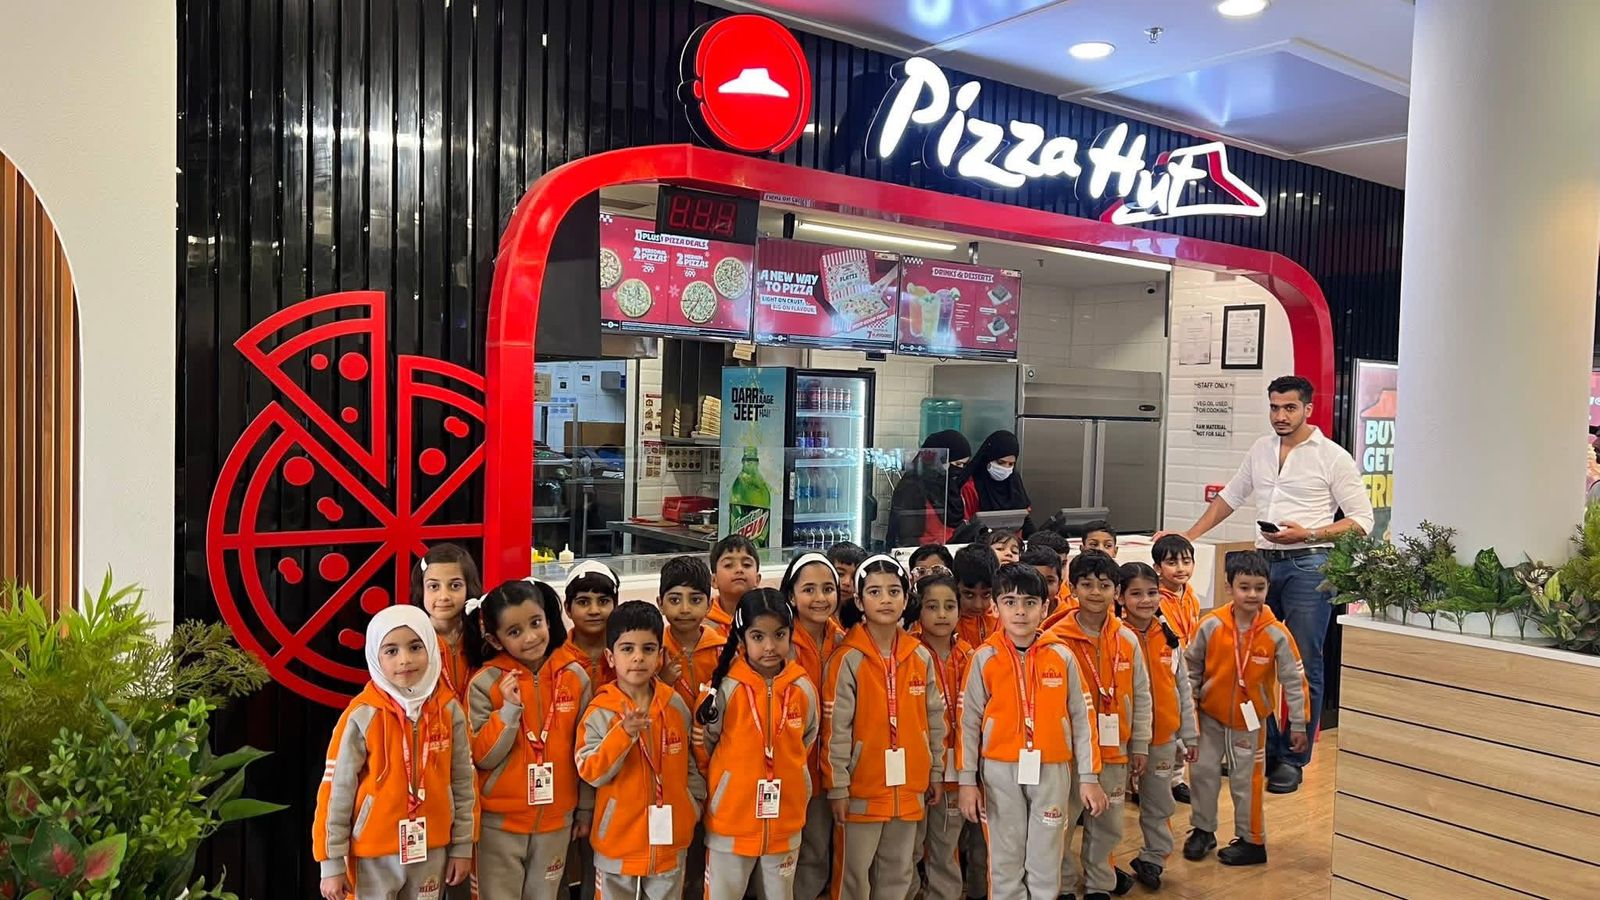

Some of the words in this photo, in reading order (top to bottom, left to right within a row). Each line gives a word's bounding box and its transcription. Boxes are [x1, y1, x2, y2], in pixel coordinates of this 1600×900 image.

[880, 56, 1082, 188] Pizza
[1088, 122, 1206, 216] Hut
[642, 232, 660, 241] PLUS
[664, 236, 684, 246] PIZZA
[686, 240, 706, 248] DEALS
[634, 247, 642, 260] 2
[642, 254, 668, 262] PIZZAS
[676, 253, 684, 265] 2
[684, 259, 709, 268] PIZZAS
[760, 270, 769, 280] A
[770, 270, 794, 282] NEW
[796, 272, 818, 285] WAY
[934, 268, 957, 276] DRINKS
[964, 272, 992, 282] DESSERTS
[765, 281, 781, 292] TO
[782, 283, 813, 296] PIZZA
[732, 387, 758, 403] DARR
[734, 404, 765, 421] JEET
